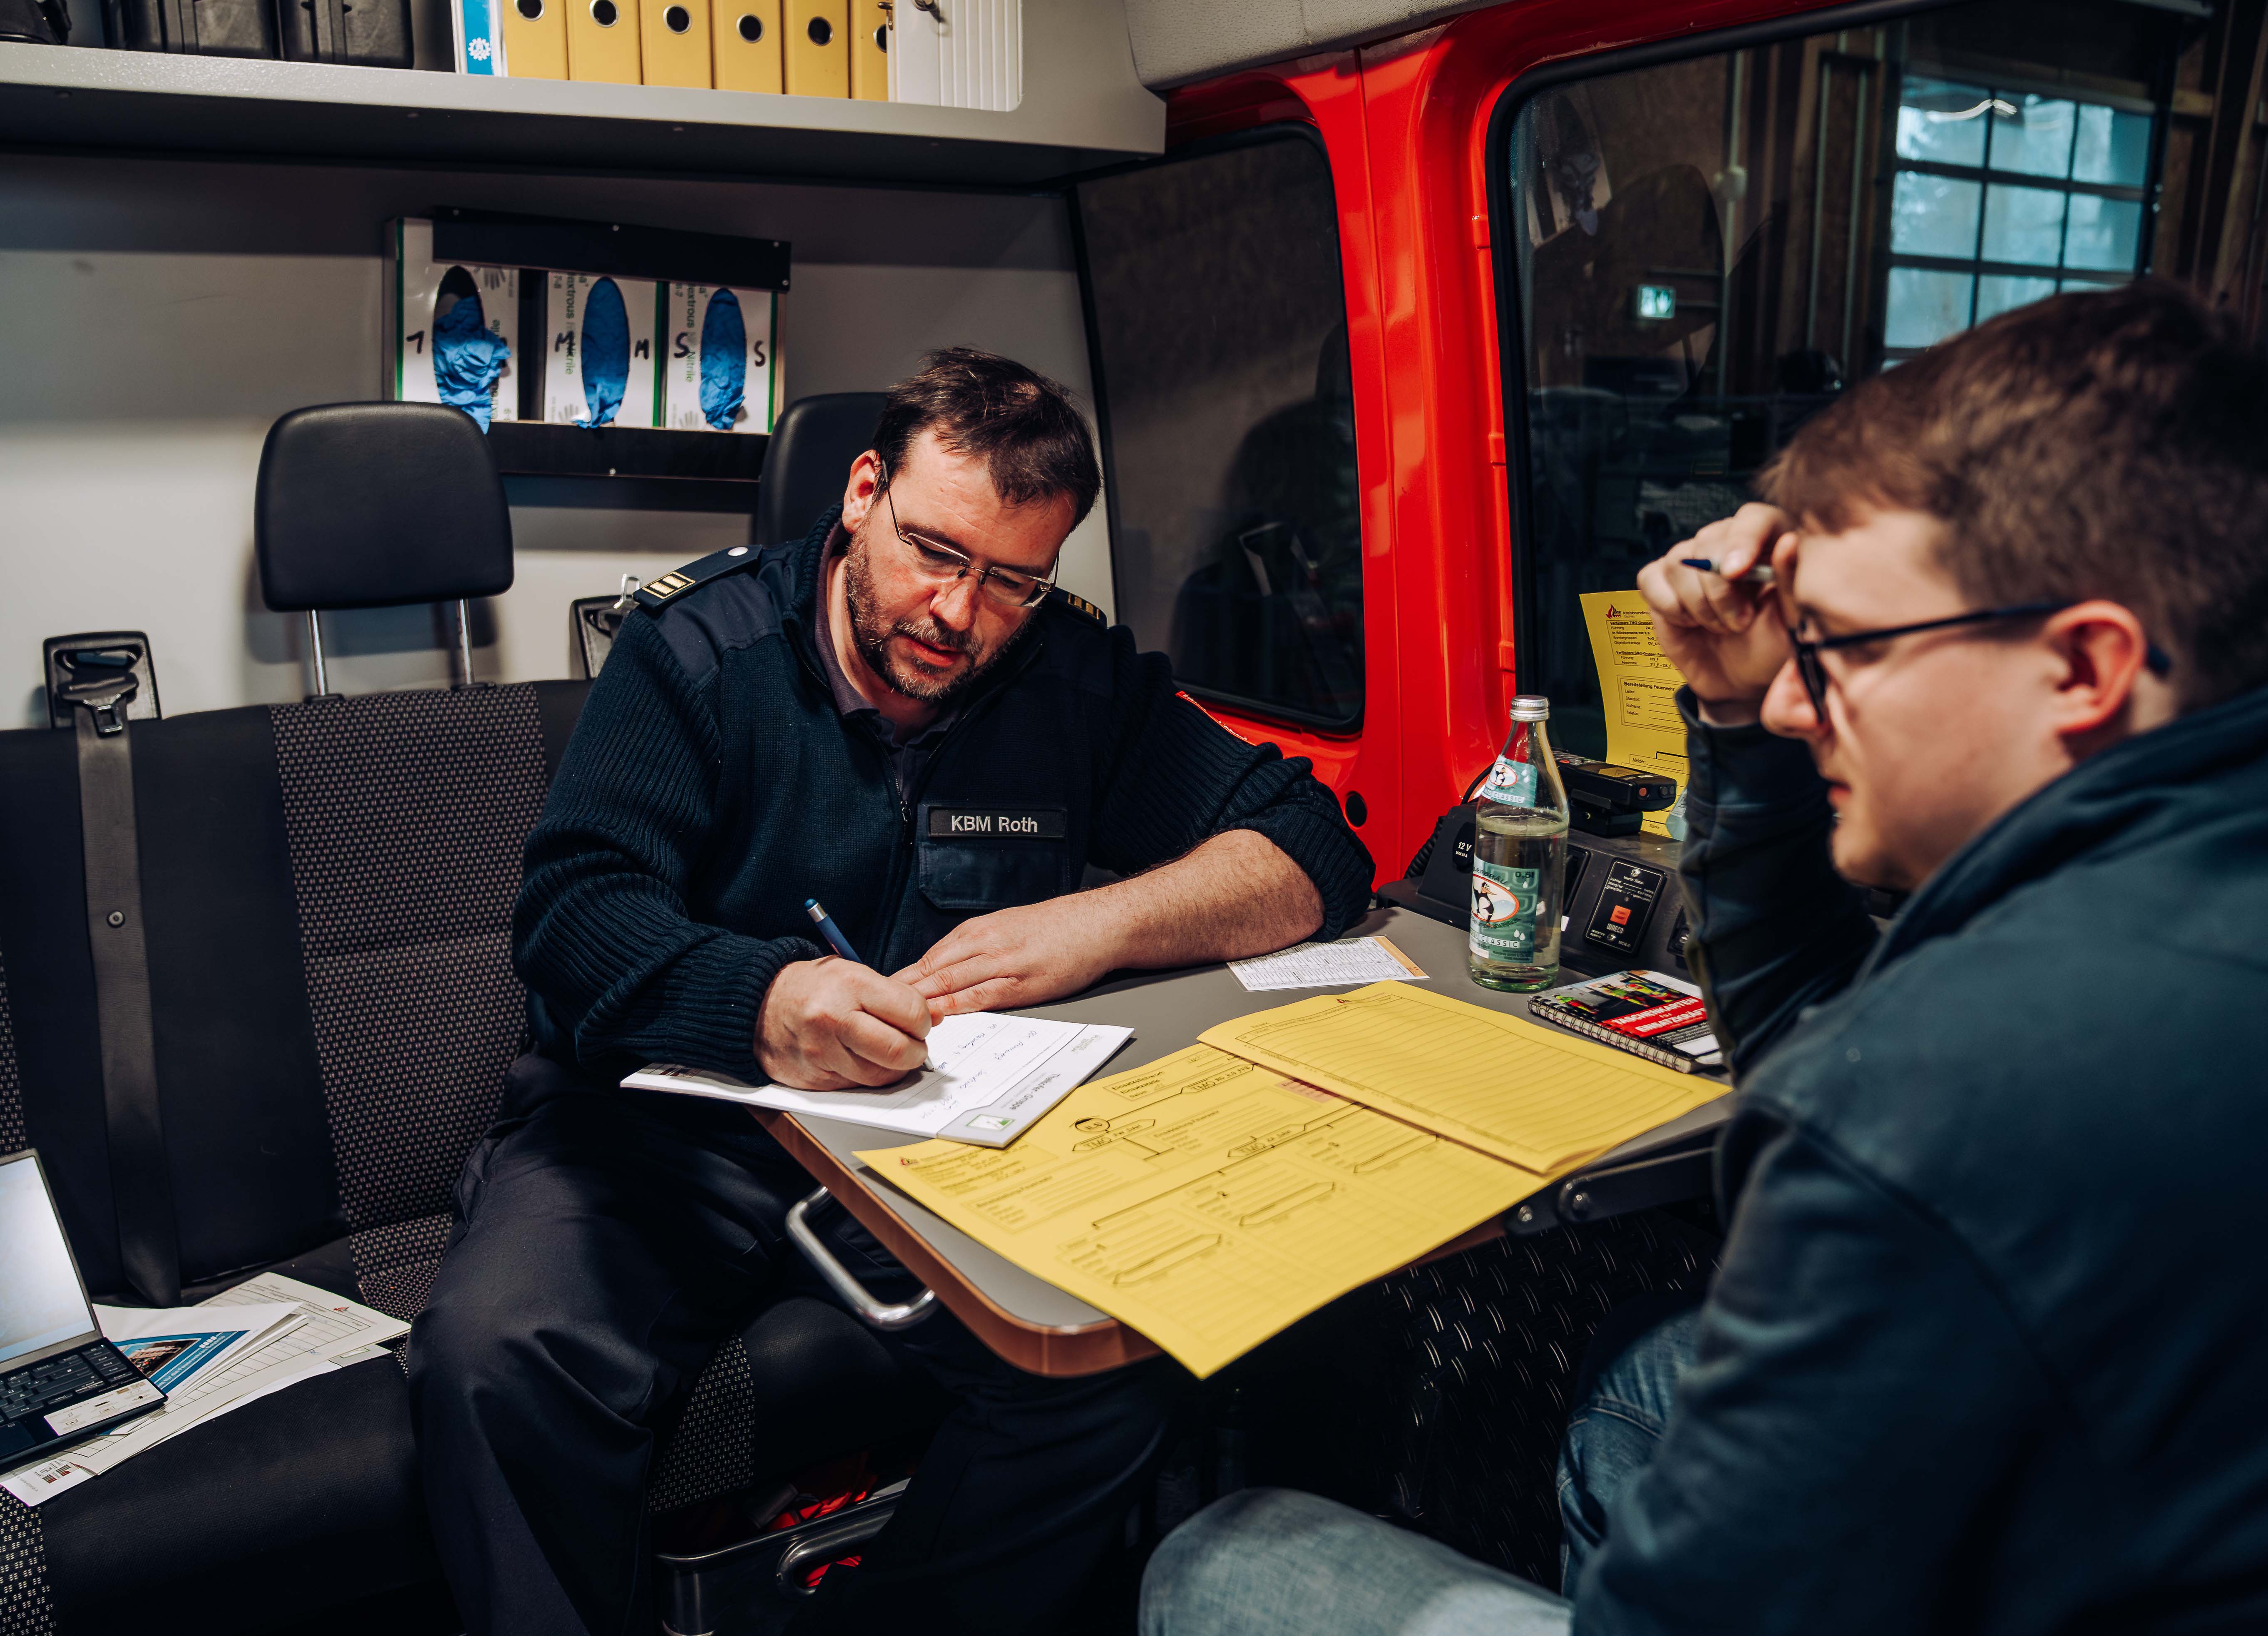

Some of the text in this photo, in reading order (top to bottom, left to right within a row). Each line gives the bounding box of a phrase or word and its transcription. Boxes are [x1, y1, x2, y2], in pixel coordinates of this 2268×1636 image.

[673, 331, 690, 358] S
[753, 340, 765, 367] S
[1493, 792, 1523, 802] CLASSIC
[951, 815, 1038, 833] KBM Roth
[1458, 842, 1472, 852] 12 V
[1607, 923, 1624, 934] WAECO
[1481, 935, 1518, 947] CLASSIC
[1611, 998, 1699, 1025] TASCHENKARTEN
[1190, 1081, 1215, 1091] TMO
[1085, 1121, 1103, 1130] ILS
[1087, 1137, 1112, 1148] TMO
